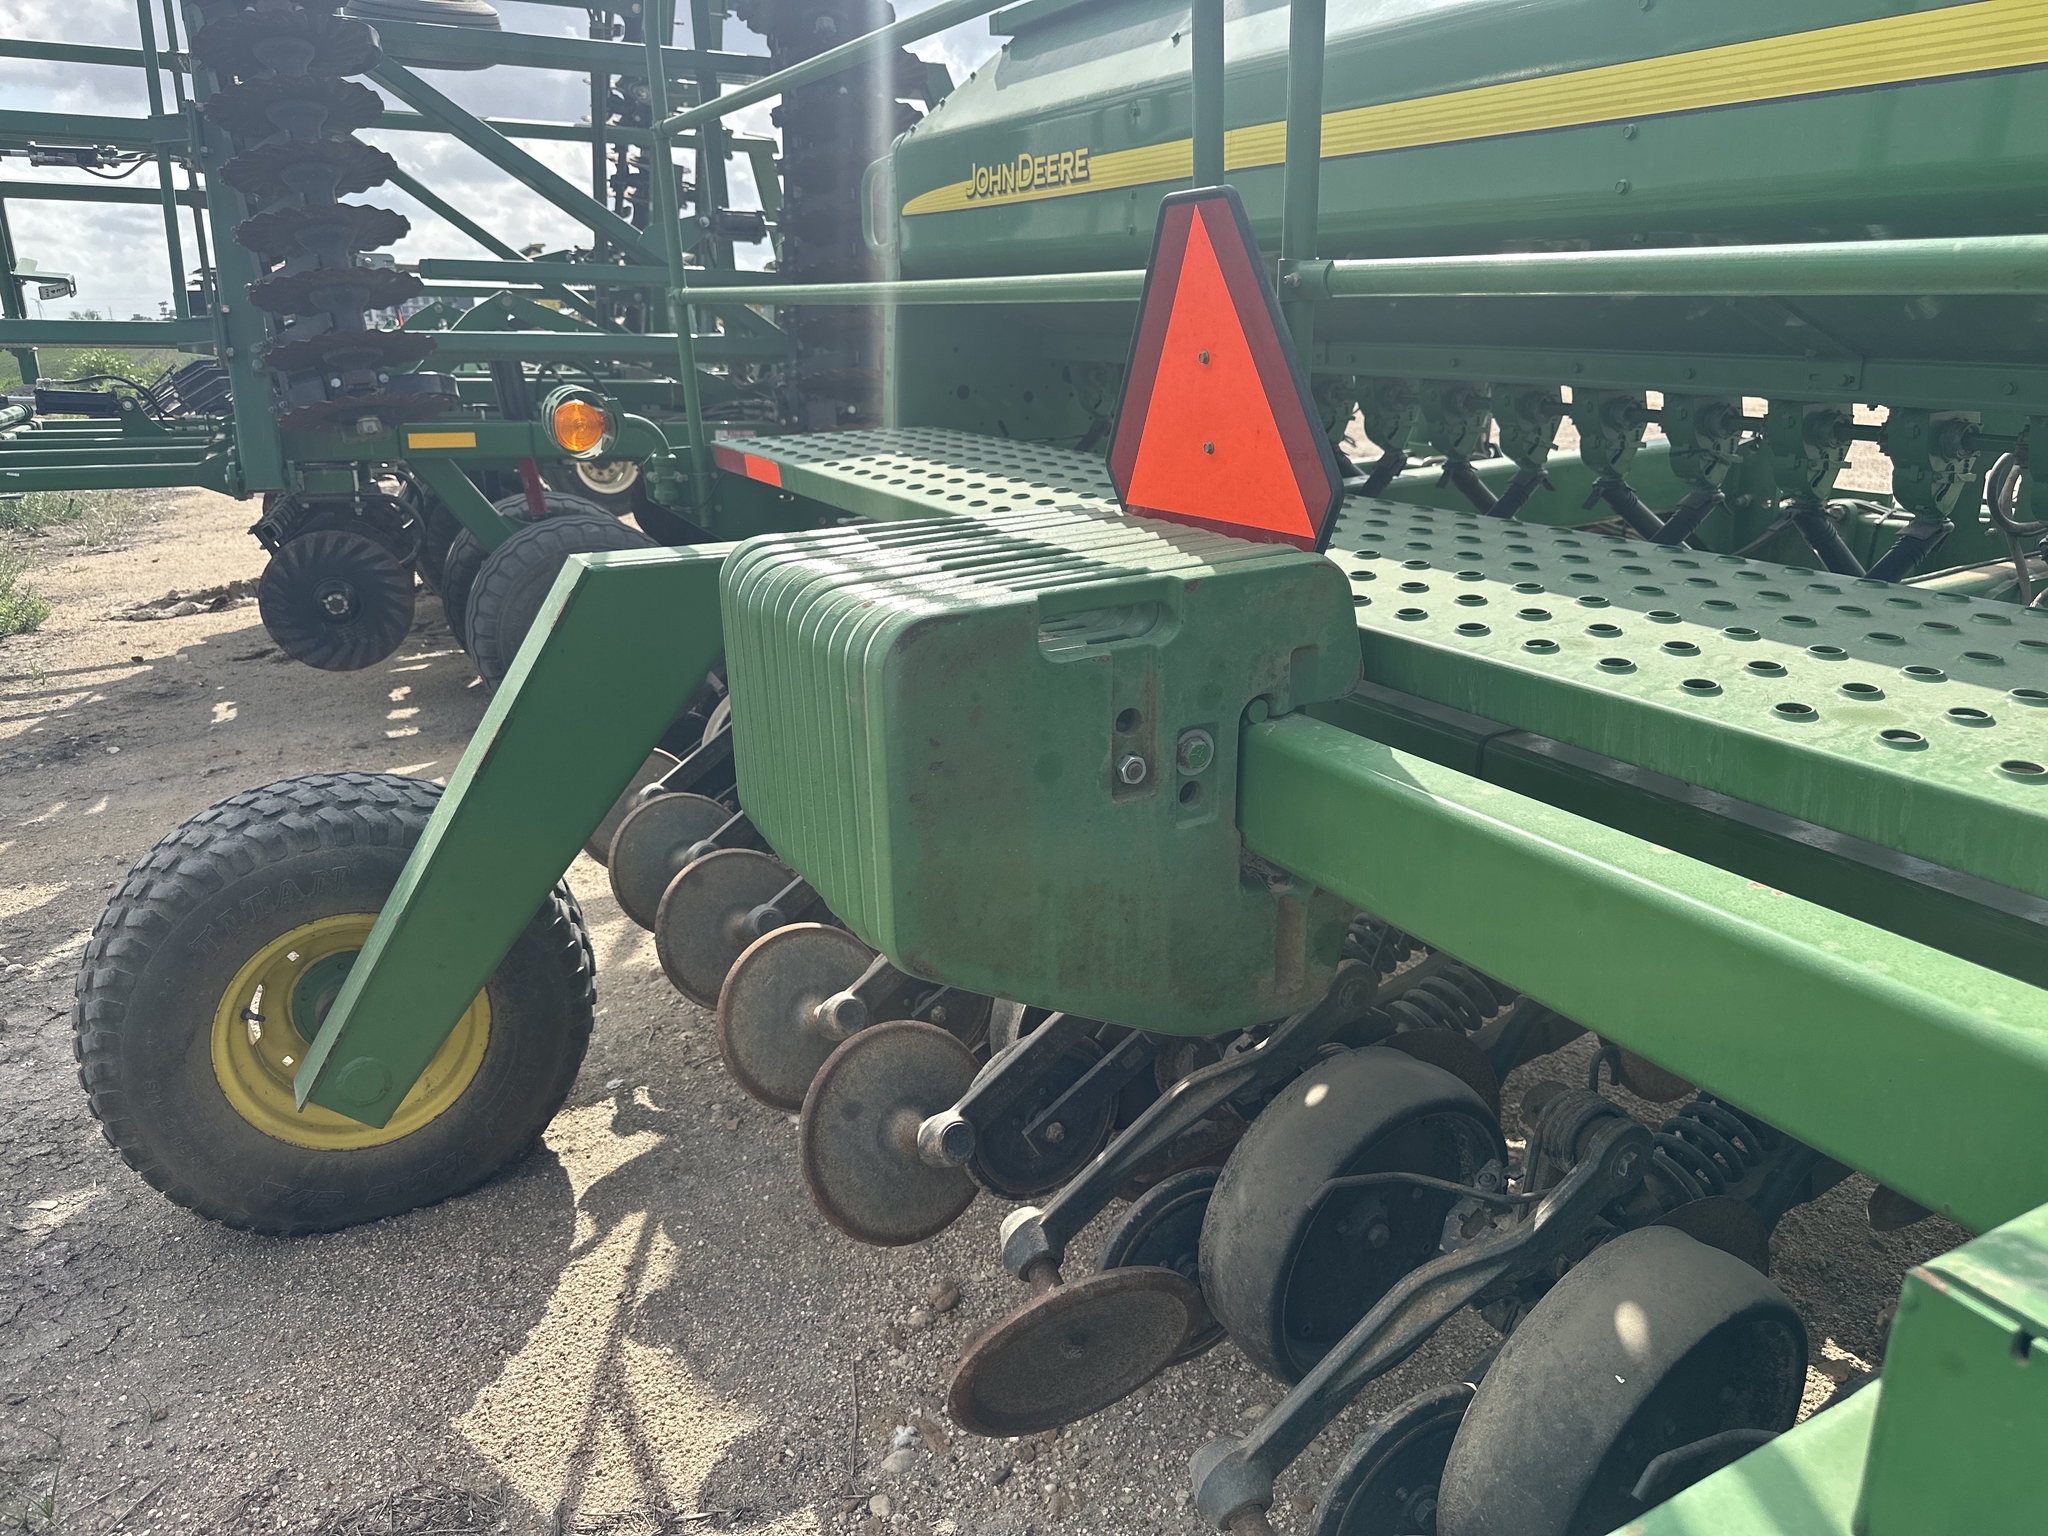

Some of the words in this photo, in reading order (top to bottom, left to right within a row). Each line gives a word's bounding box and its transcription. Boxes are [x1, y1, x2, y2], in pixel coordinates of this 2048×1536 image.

[965, 162, 1015, 198] JOHN
[1018, 147, 1089, 190] DEERE
[189, 866, 348, 960] TITAN
